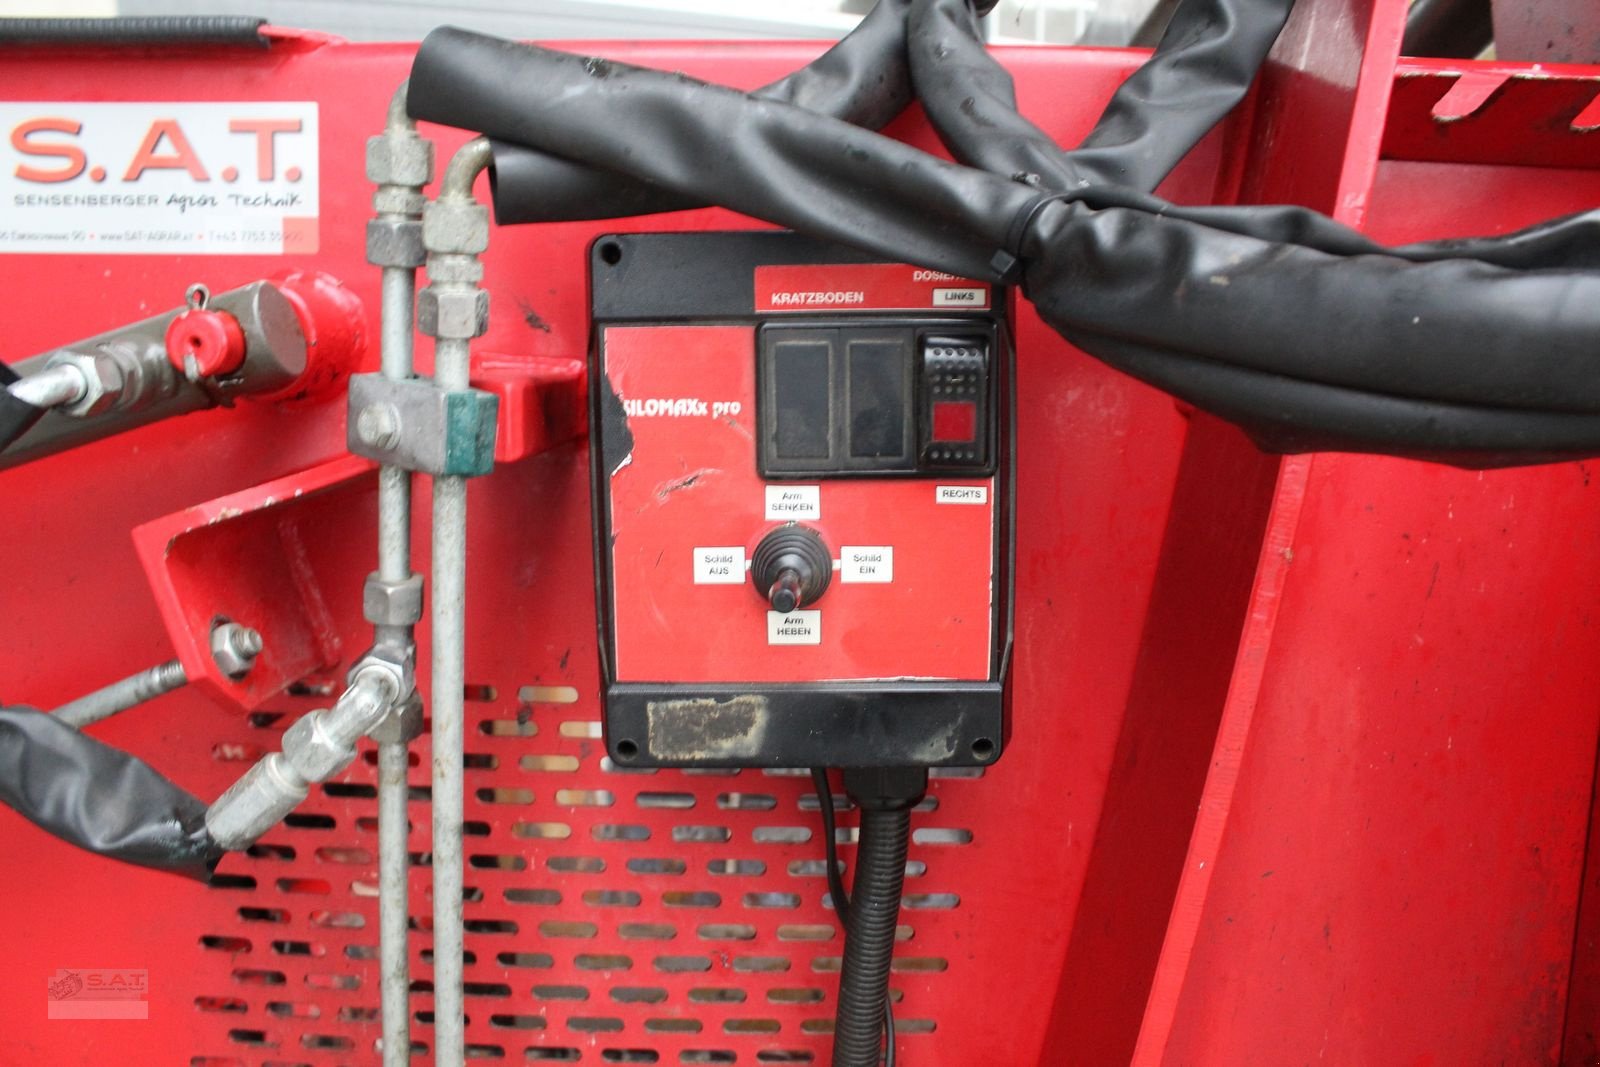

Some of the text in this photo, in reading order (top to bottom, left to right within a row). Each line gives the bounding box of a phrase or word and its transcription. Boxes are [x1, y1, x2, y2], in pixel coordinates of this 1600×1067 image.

[10, 117, 303, 183] S.A.T.
[14, 193, 303, 213] SENSENBERGER Agrar Technik
[771, 292, 864, 305] KRATZBODEN
[944, 292, 975, 300] LINKS
[712, 401, 742, 420] pro
[782, 492, 803, 501] Arm
[942, 489, 981, 498] RECHTS
[771, 503, 813, 511] SENKEN
[704, 554, 733, 563] Schild
[853, 553, 882, 563] Schild
[709, 566, 729, 575] AUS
[859, 565, 876, 574] EIN
[783, 616, 804, 625] Arm
[776, 627, 812, 636] HEBEN
